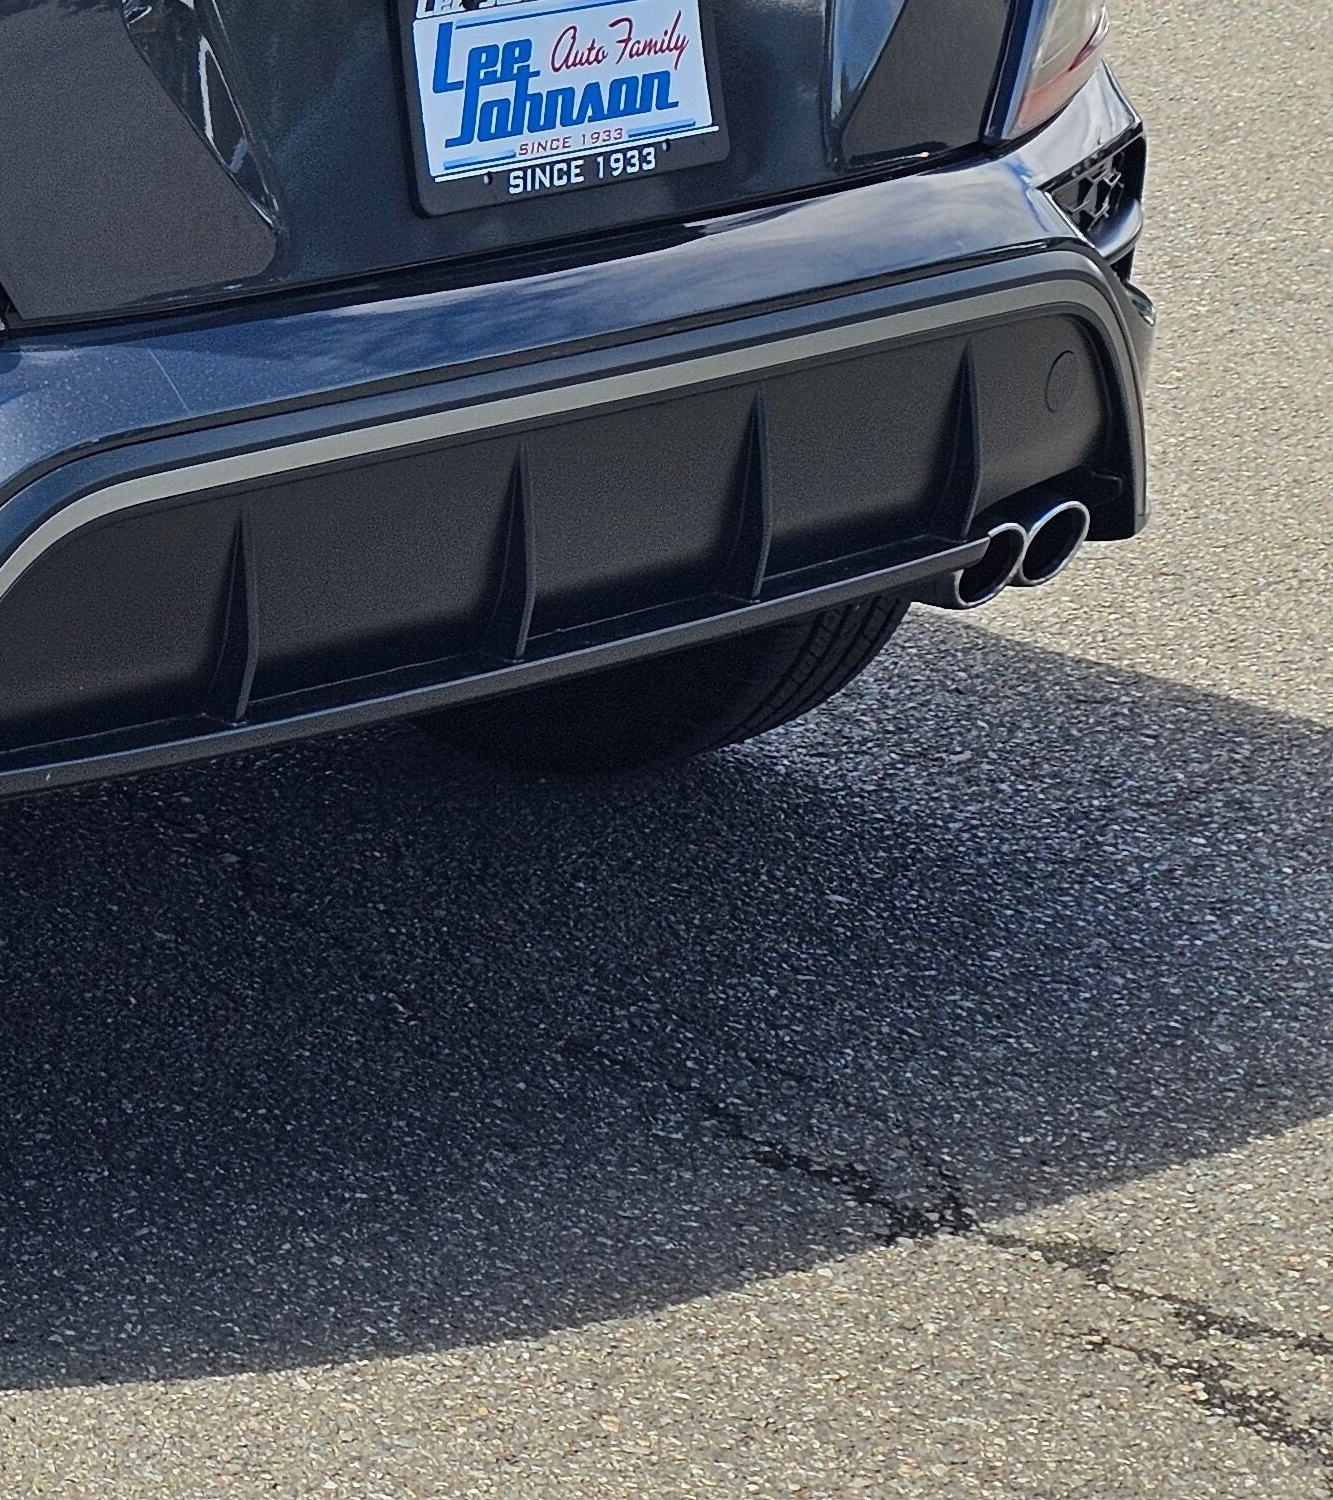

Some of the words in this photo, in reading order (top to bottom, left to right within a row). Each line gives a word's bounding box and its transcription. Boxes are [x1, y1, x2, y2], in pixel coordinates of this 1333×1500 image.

[433, 21, 533, 94] Lee
[549, 25, 609, 74] Auto
[608, 10, 690, 71] Family
[444, 60, 680, 149] Johnson
[508, 160, 585, 195] SINCE
[596, 146, 658, 180] 1933
[518, 135, 572, 157] SINCE
[581, 127, 624, 147] 1933
